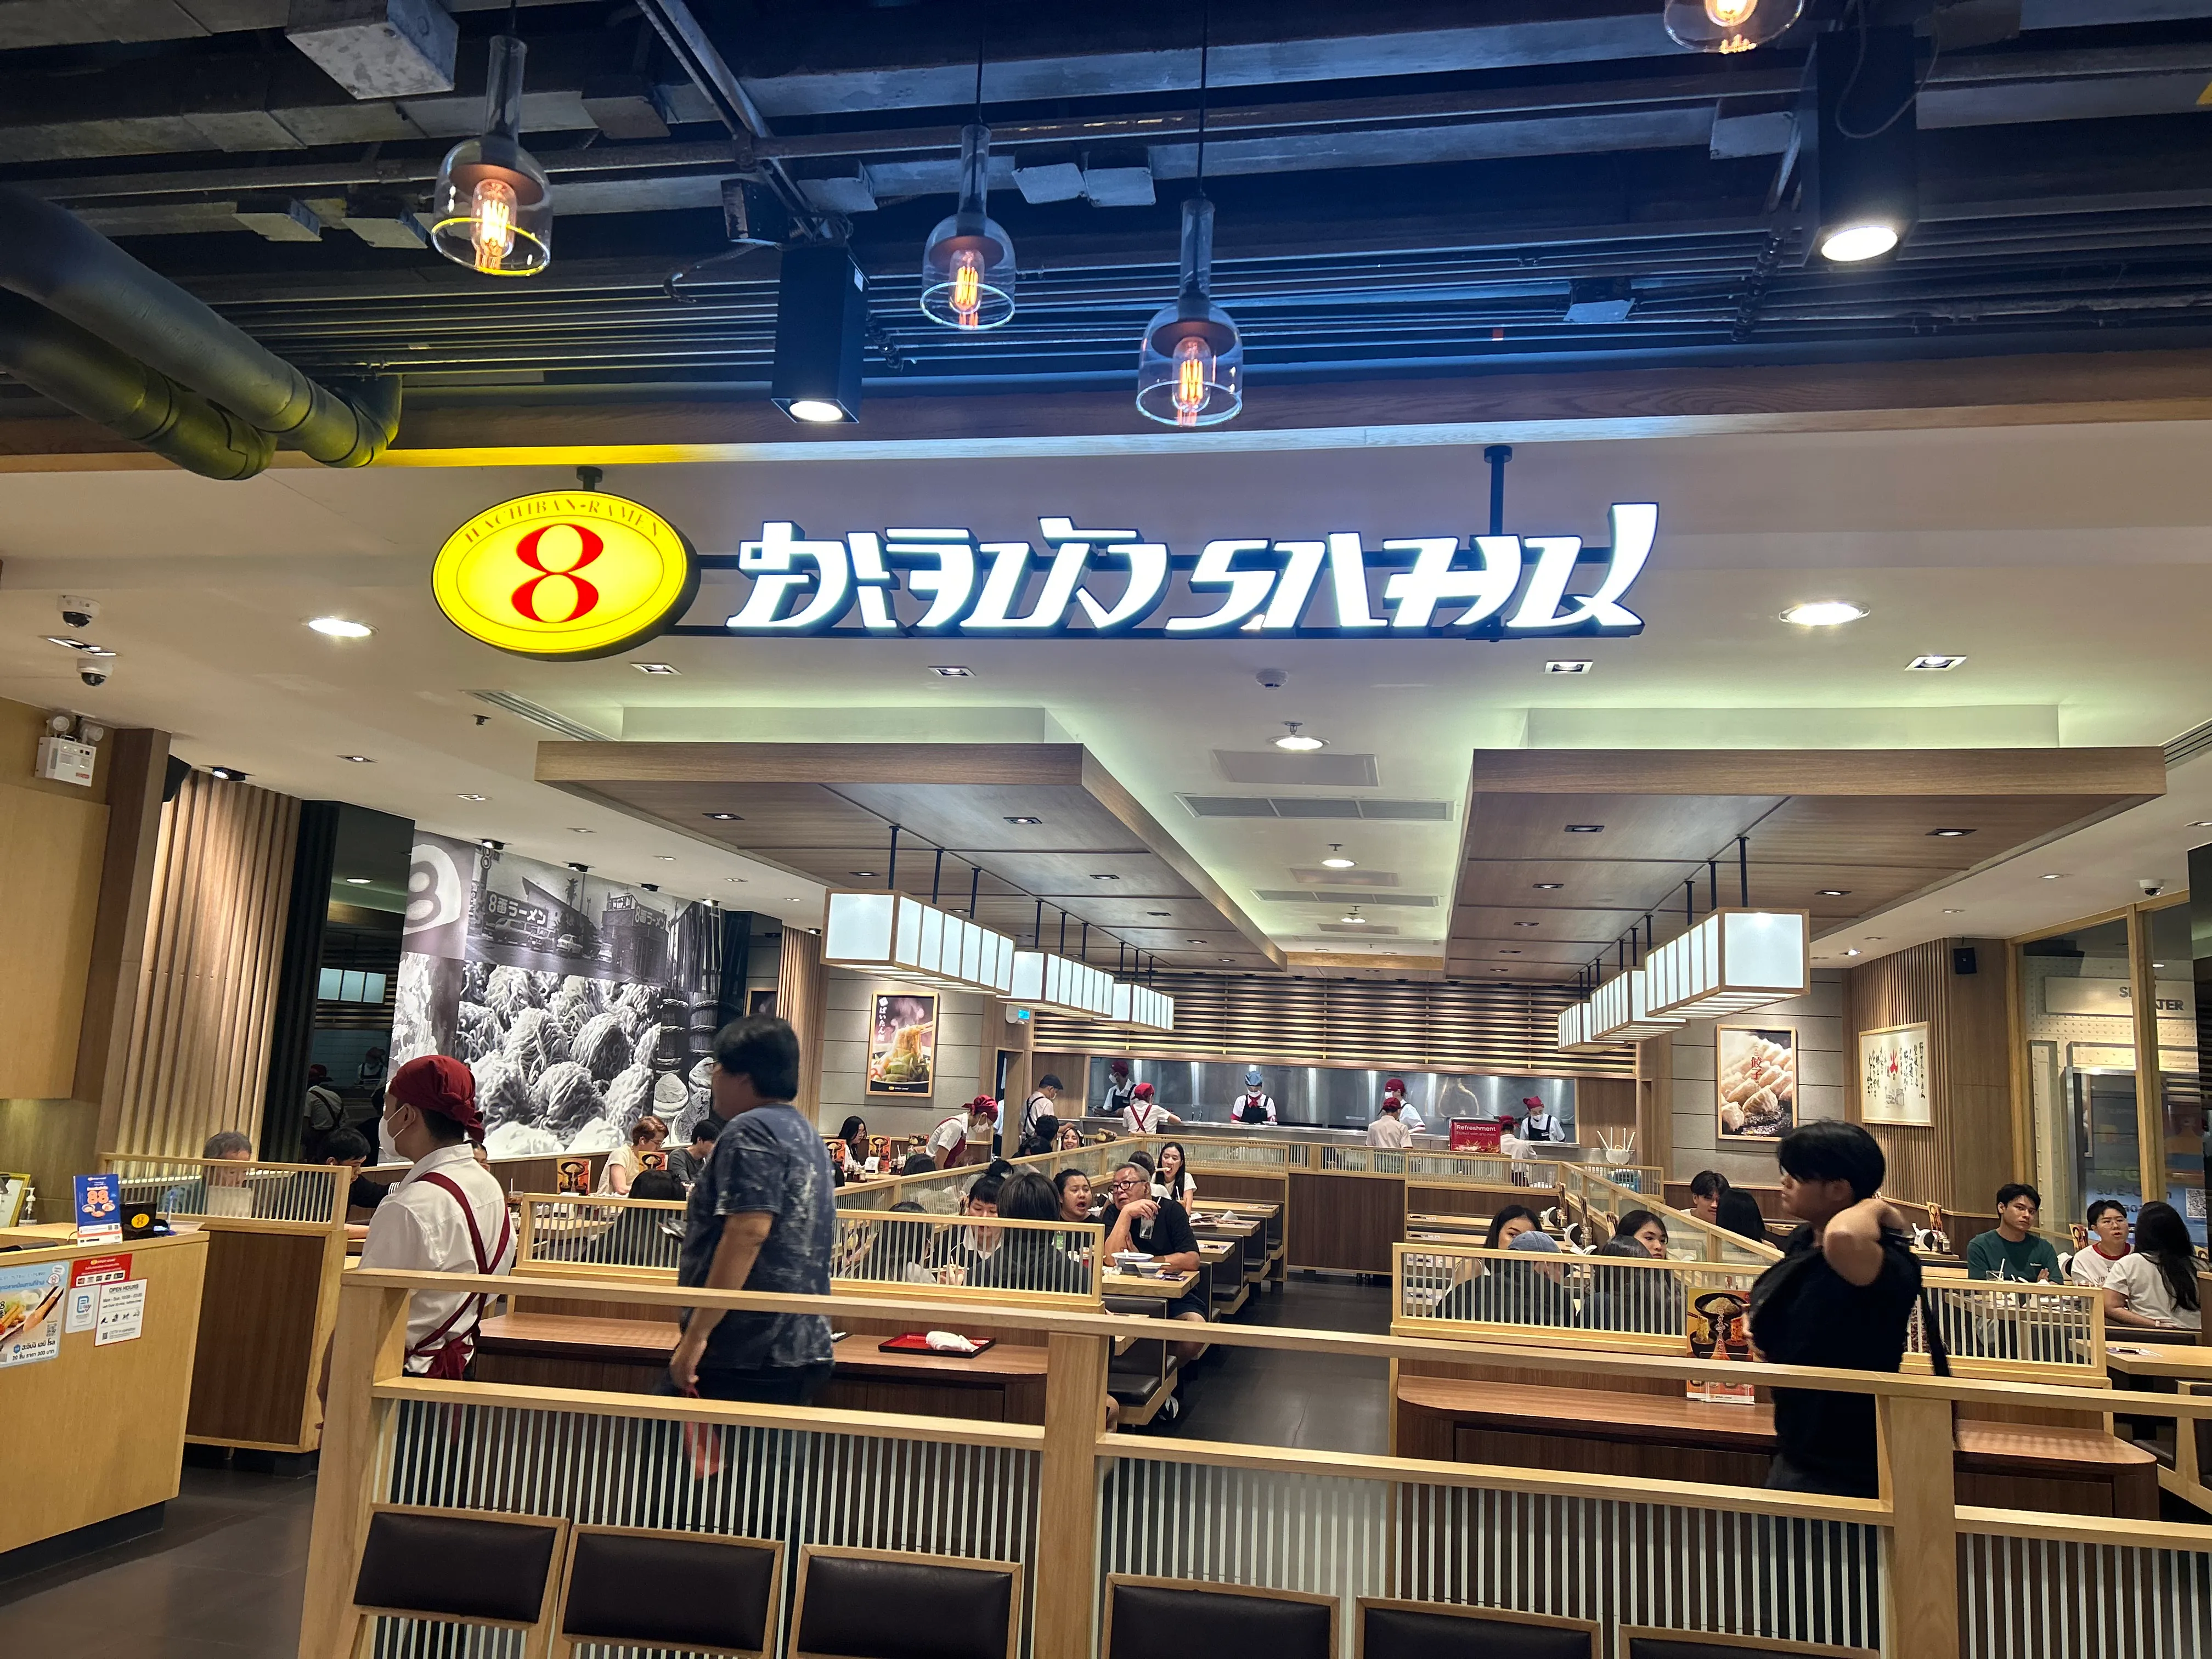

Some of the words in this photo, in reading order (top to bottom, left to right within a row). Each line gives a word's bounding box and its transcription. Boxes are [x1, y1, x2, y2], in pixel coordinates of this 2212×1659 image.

[511, 522, 604, 624] 8
[488, 893, 547, 925] 8番ラーメン
[634, 906, 665, 930] 8番ラーメン
[137, 1216, 144, 1226] 8
